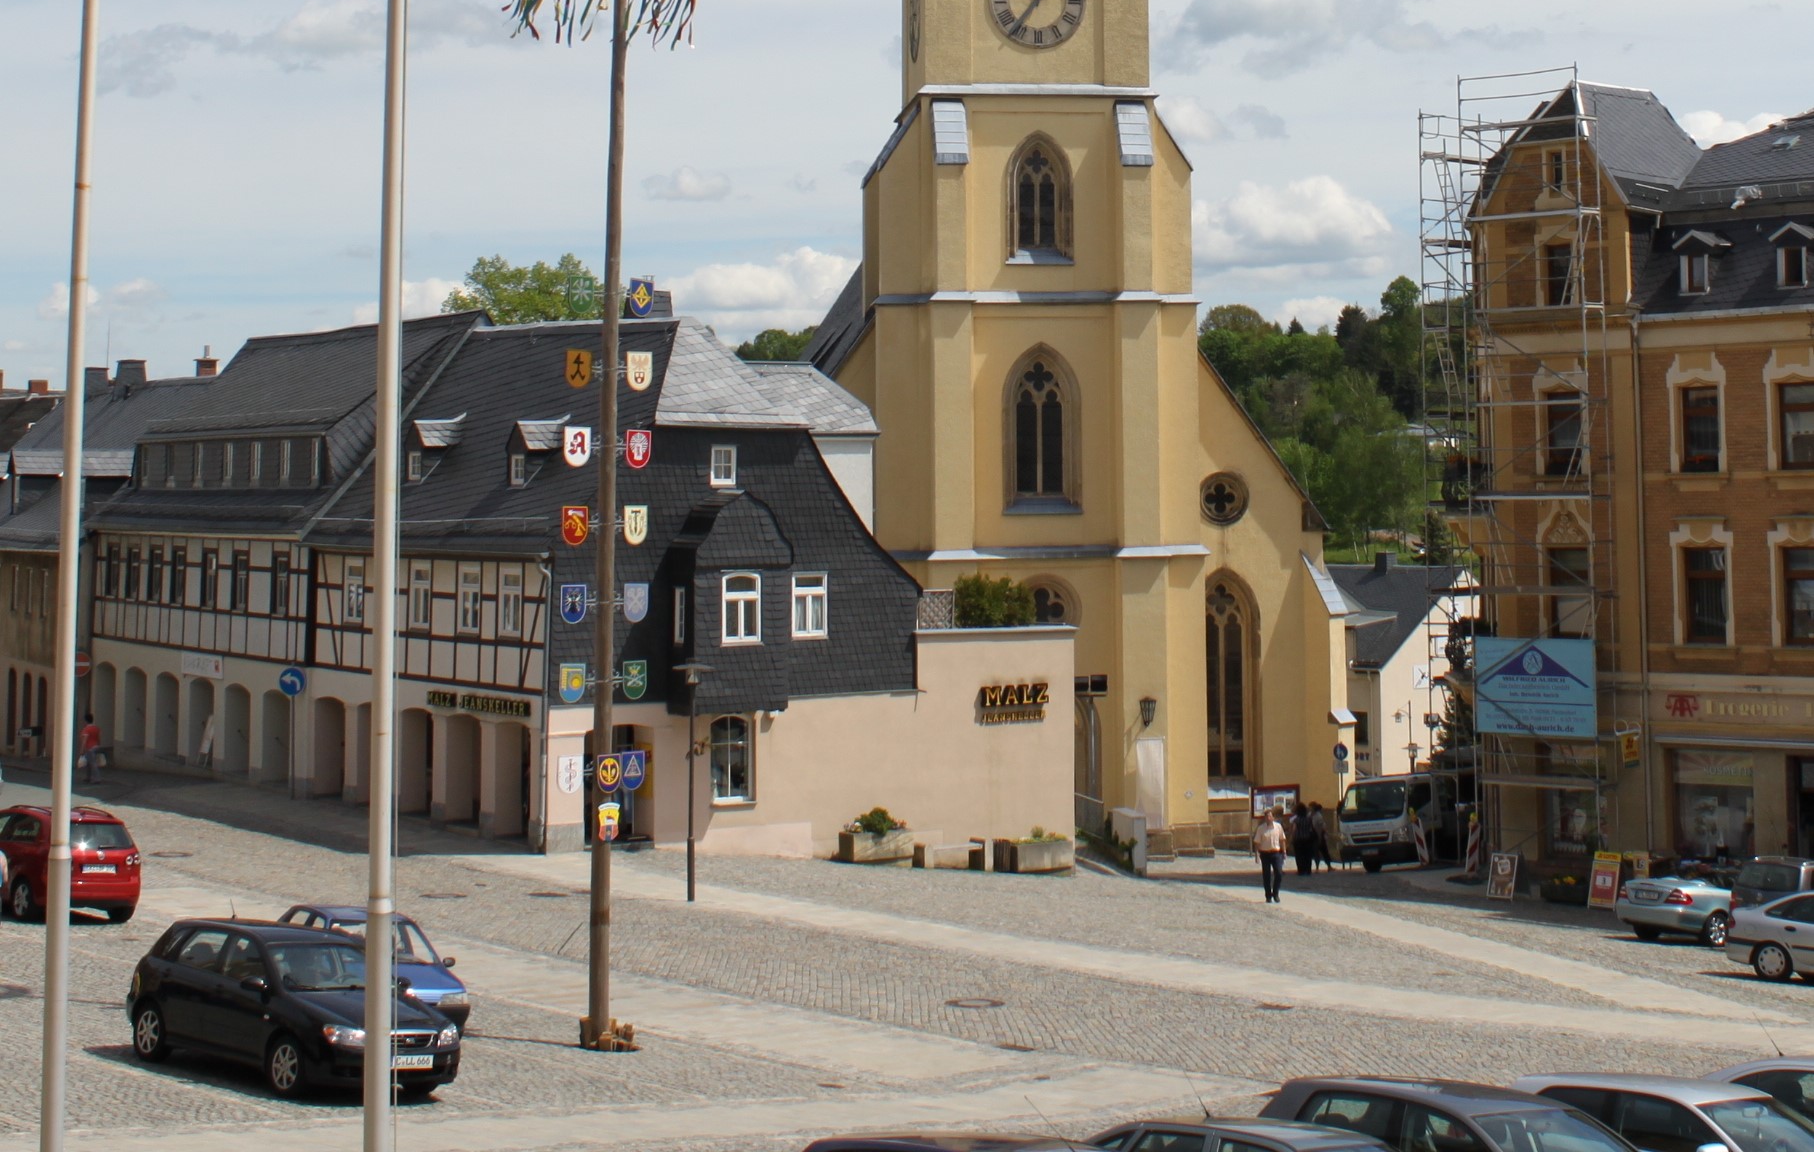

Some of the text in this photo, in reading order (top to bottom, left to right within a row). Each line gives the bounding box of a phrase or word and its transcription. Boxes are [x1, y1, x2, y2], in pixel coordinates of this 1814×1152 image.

[427, 692, 526, 716] MALZ JEANSKELLER
[982, 683, 1049, 707] MALZ
[1706, 699, 1789, 717] Drogerie
